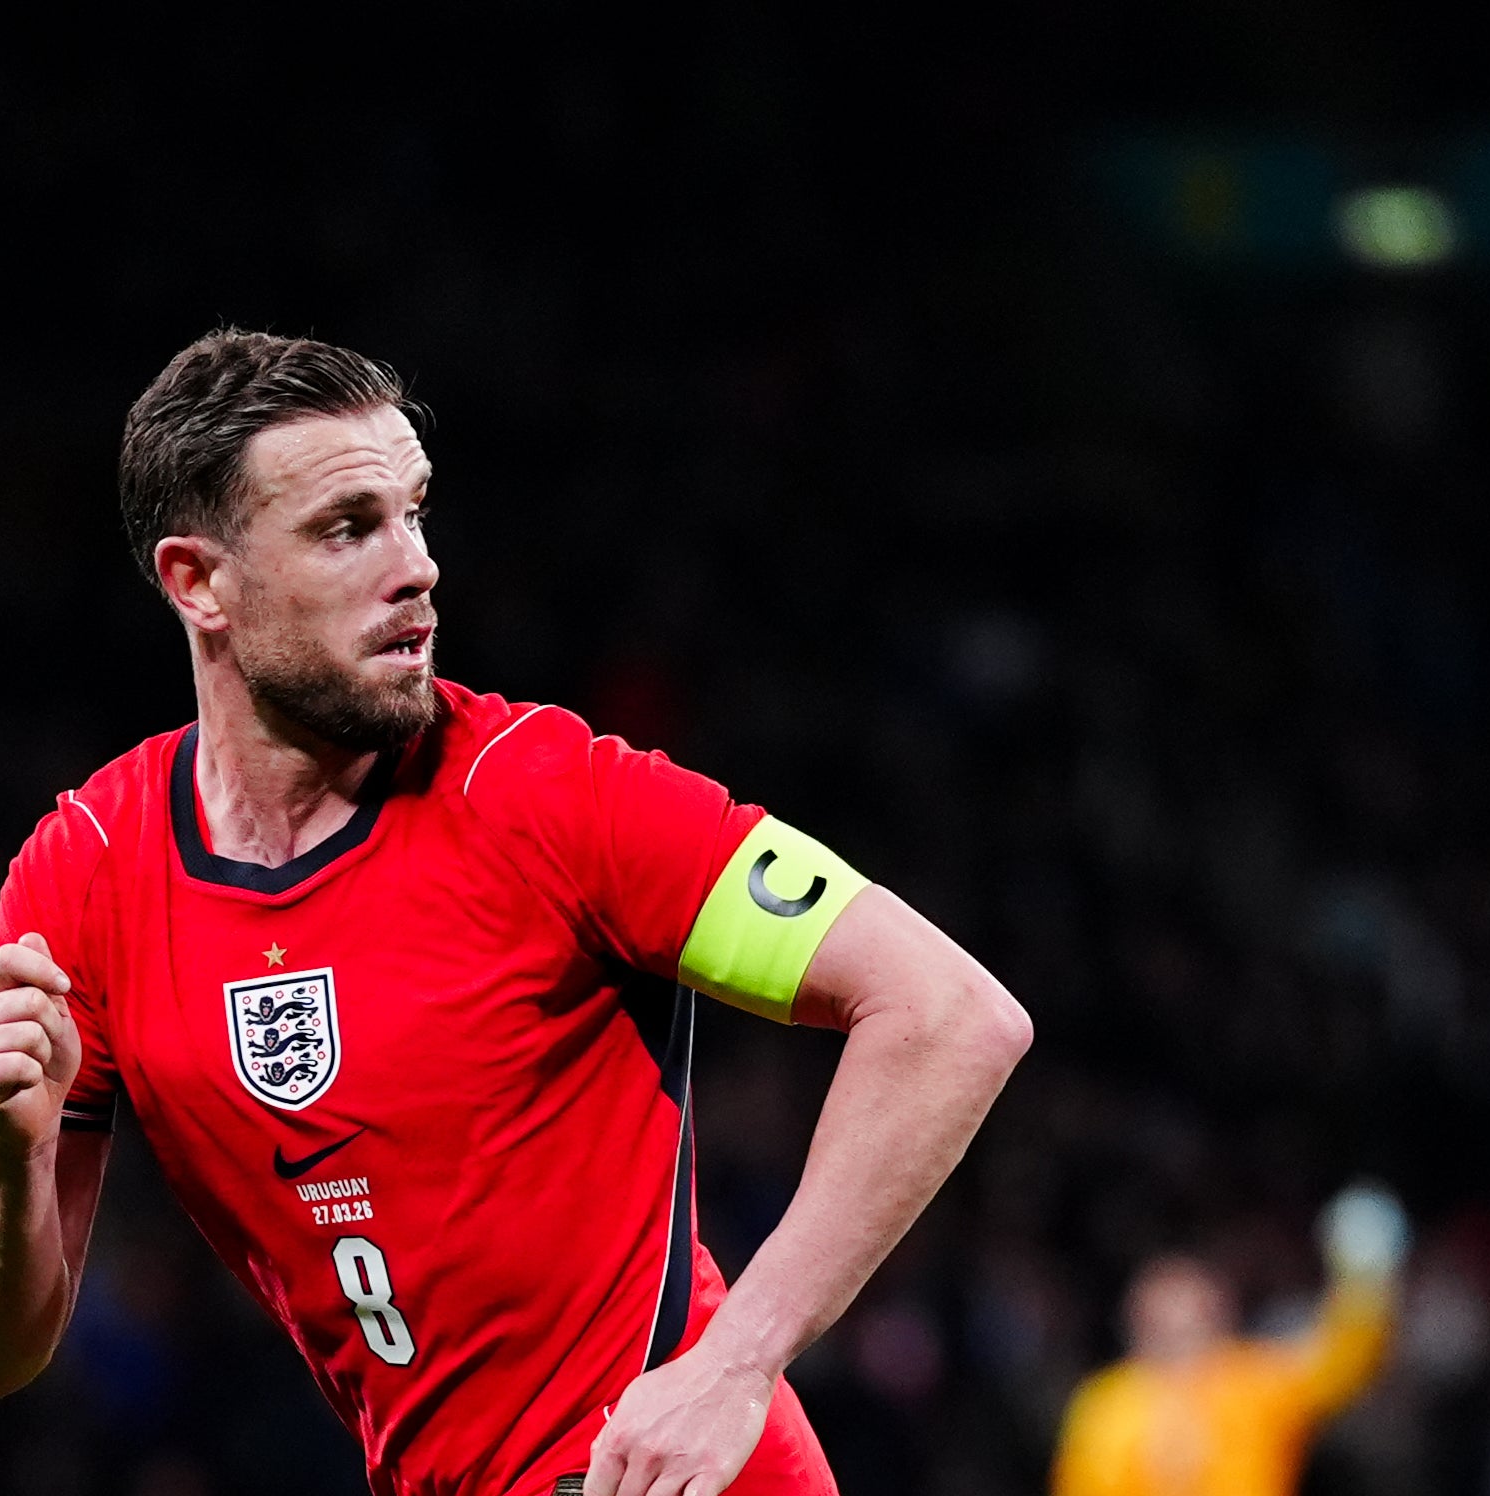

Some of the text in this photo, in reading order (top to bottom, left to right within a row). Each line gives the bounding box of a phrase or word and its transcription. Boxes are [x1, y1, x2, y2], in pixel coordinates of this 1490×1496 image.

[748, 849, 827, 918] C
[296, 1177, 370, 1202] URUGUAY
[312, 1200, 374, 1225] 27.03.26
[332, 1236, 416, 1366] 8
